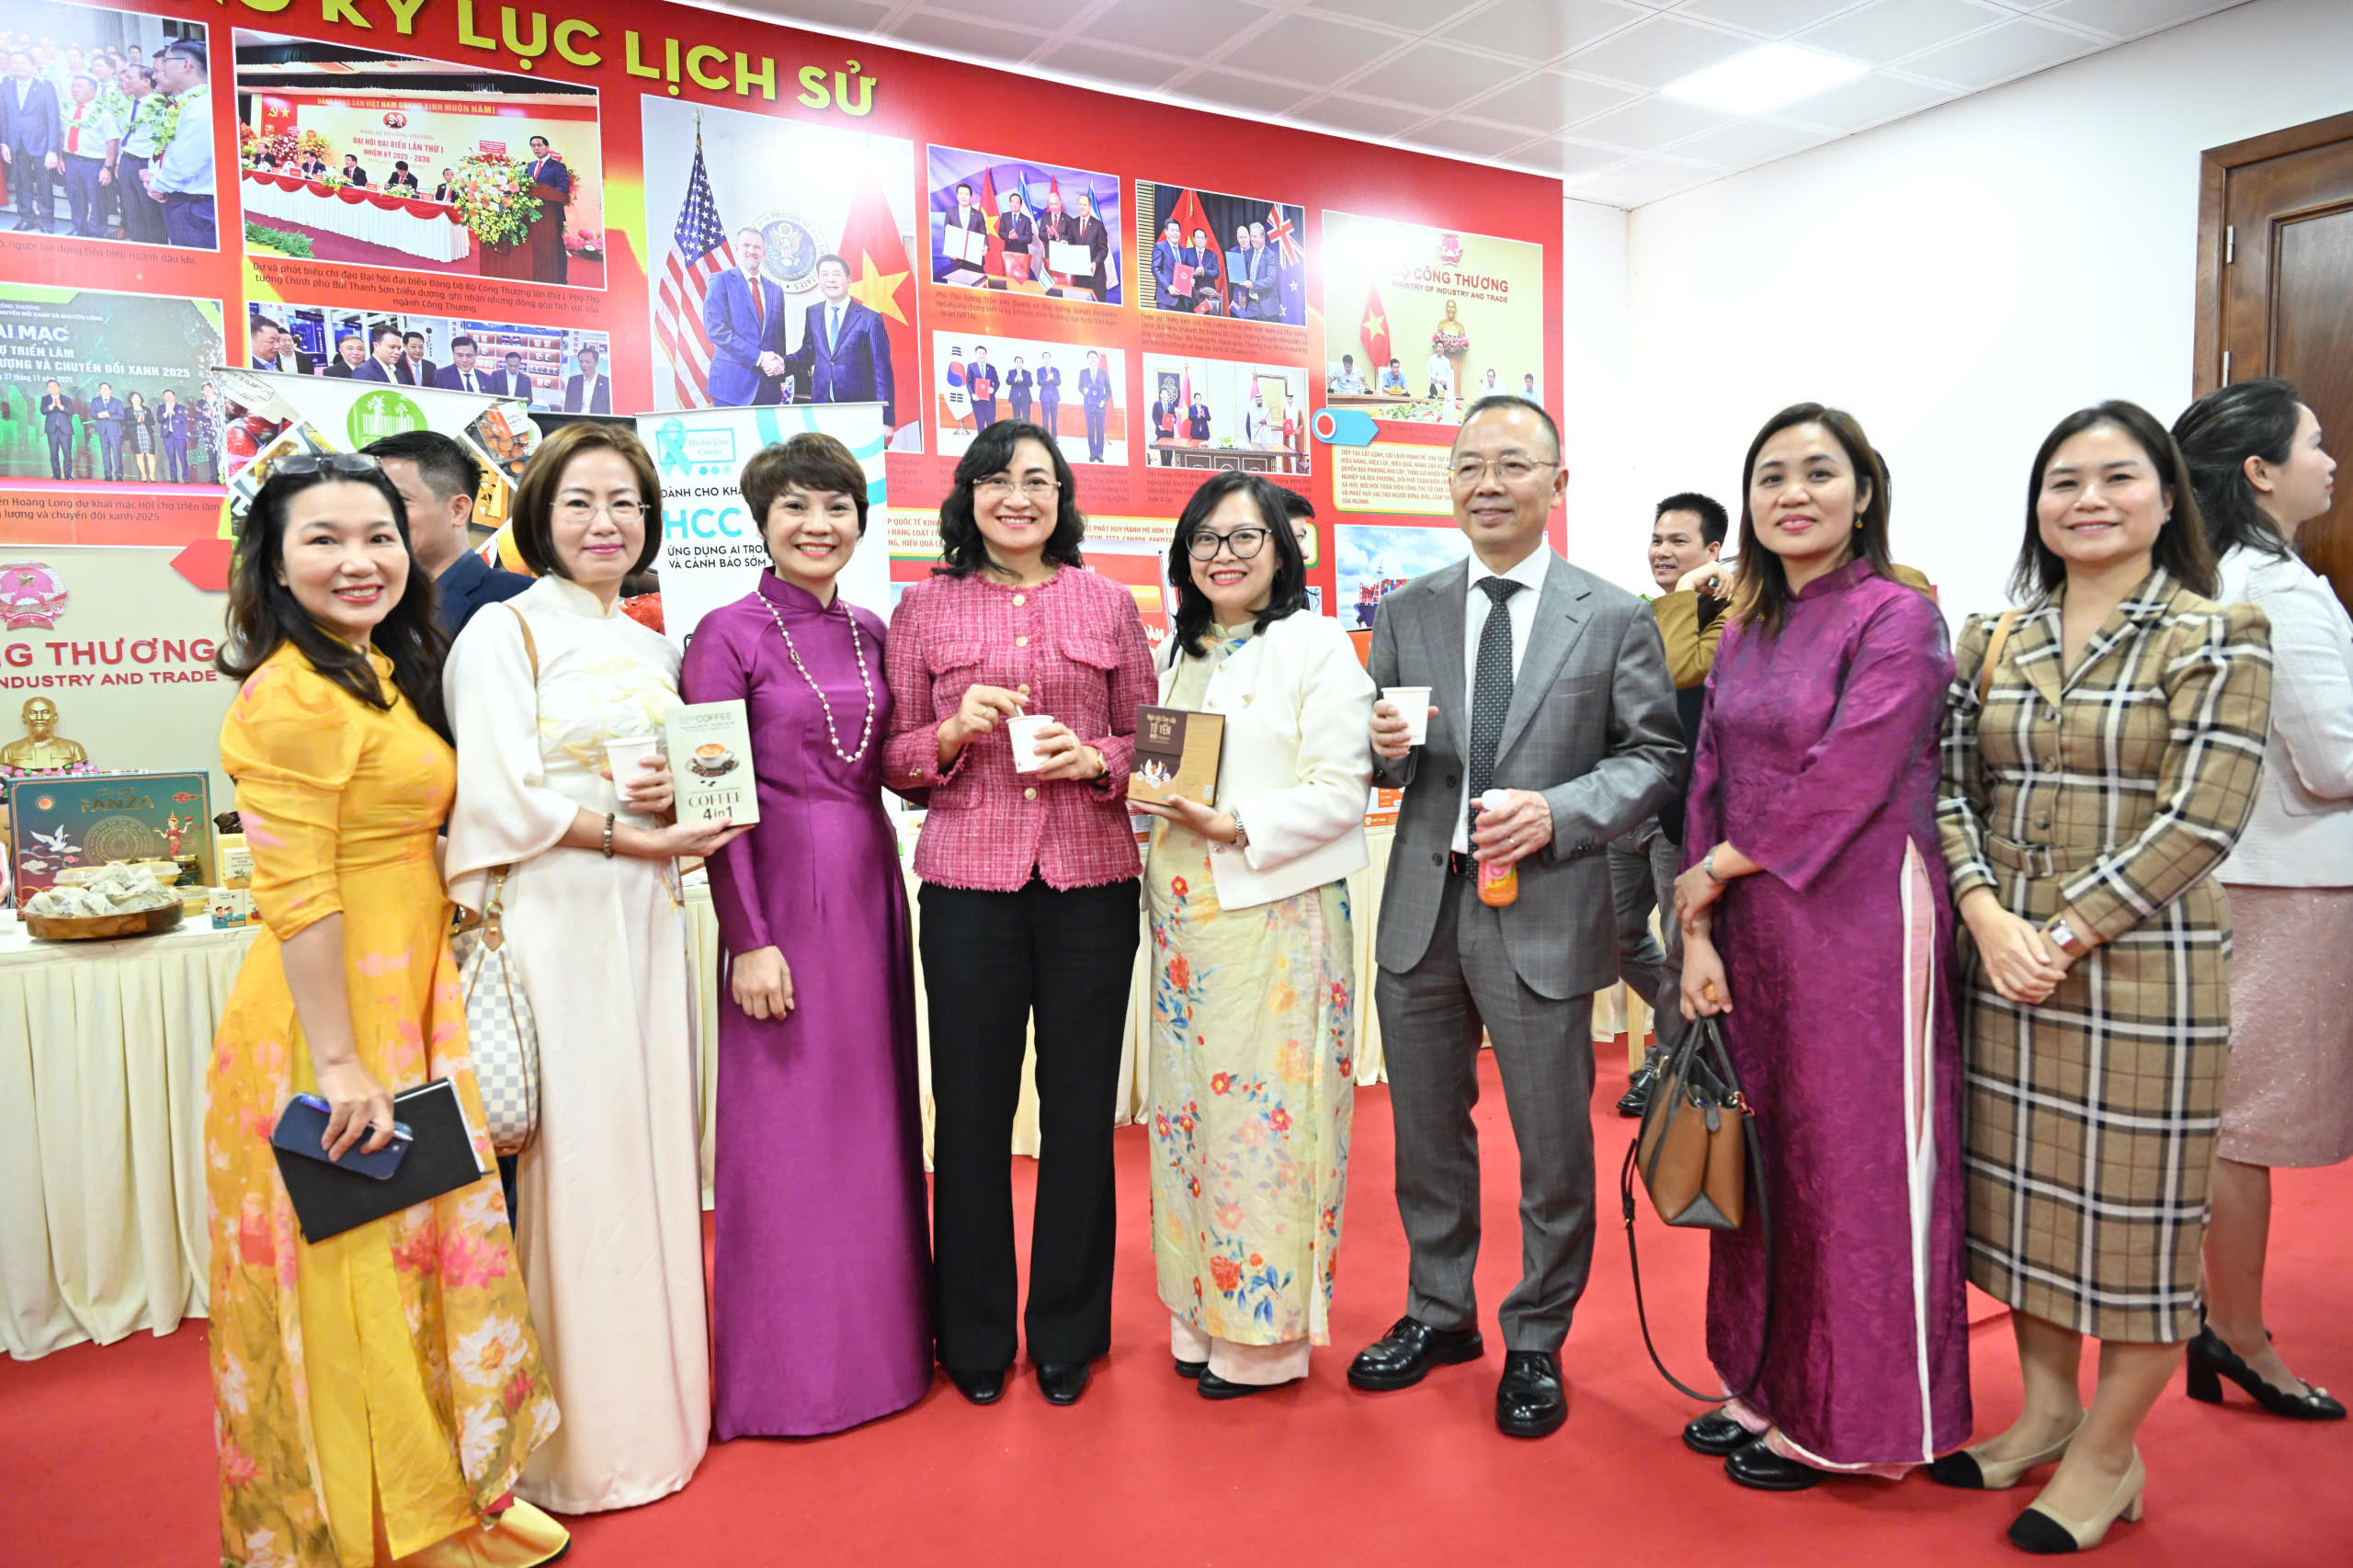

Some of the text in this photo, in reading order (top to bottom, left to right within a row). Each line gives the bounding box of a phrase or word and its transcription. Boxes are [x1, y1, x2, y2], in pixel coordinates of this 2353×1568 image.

[459, 0, 601, 70] LỤC
[625, 29, 776, 99] LỊCH
[797, 61, 877, 117] SỬ
[268, 263, 278, 272] và
[281, 265, 301, 277] phát
[342, 271, 357, 281] đạo
[377, 274, 390, 285] hội
[430, 279, 450, 291] Đảng
[453, 281, 463, 292] bộ
[466, 283, 476, 293] Bộ
[479, 284, 498, 296] Công
[501, 287, 531, 299] Thương
[1454, 273, 1507, 292] THƯƠNG
[313, 278, 329, 290] phủ
[350, 283, 376, 292] Thanh
[379, 286, 393, 294] Sơn
[449, 292, 461, 302] ghi
[465, 293, 484, 304] nhận
[487, 295, 513, 308] những
[516, 298, 535, 310] đóng
[538, 300, 552, 312] góp
[1392, 281, 1423, 290] ISTRY
[1437, 288, 1470, 298] INDUSTRY
[1486, 294, 1507, 303] TRADE
[393, 296, 415, 308] ngành
[418, 299, 442, 310] Công
[18, 324, 70, 345] MẠC
[12, 344, 45, 358] TRIỂN
[50, 346, 74, 358] LÃM
[36, 358, 51, 370] VÀ
[55, 358, 101, 373] CHUYỂN
[105, 360, 124, 374] ĐỔI
[129, 366, 159, 376] XANH
[162, 368, 190, 378] 2025
[695, 487, 719, 496] CHO
[12, 498, 45, 508] Hoàng
[49, 499, 72, 509] Long
[51, 511, 87, 522] chuyển
[108, 513, 132, 521] xanh
[664, 507, 743, 540] HCC
[668, 544, 690, 556] ỨNG
[695, 546, 726, 557] DỤNG
[731, 546, 740, 554] AI
[669, 555, 766, 569] VÀ CẢNH BÁO SỚM
[0, 637, 215, 666] G THƯƠNG
[101, 673, 143, 686] AND
[149, 670, 218, 684] TRADE
[696, 712, 734, 722] COFFEE
[81, 795, 154, 812] FANZA
[688, 791, 743, 807] COFFEE
